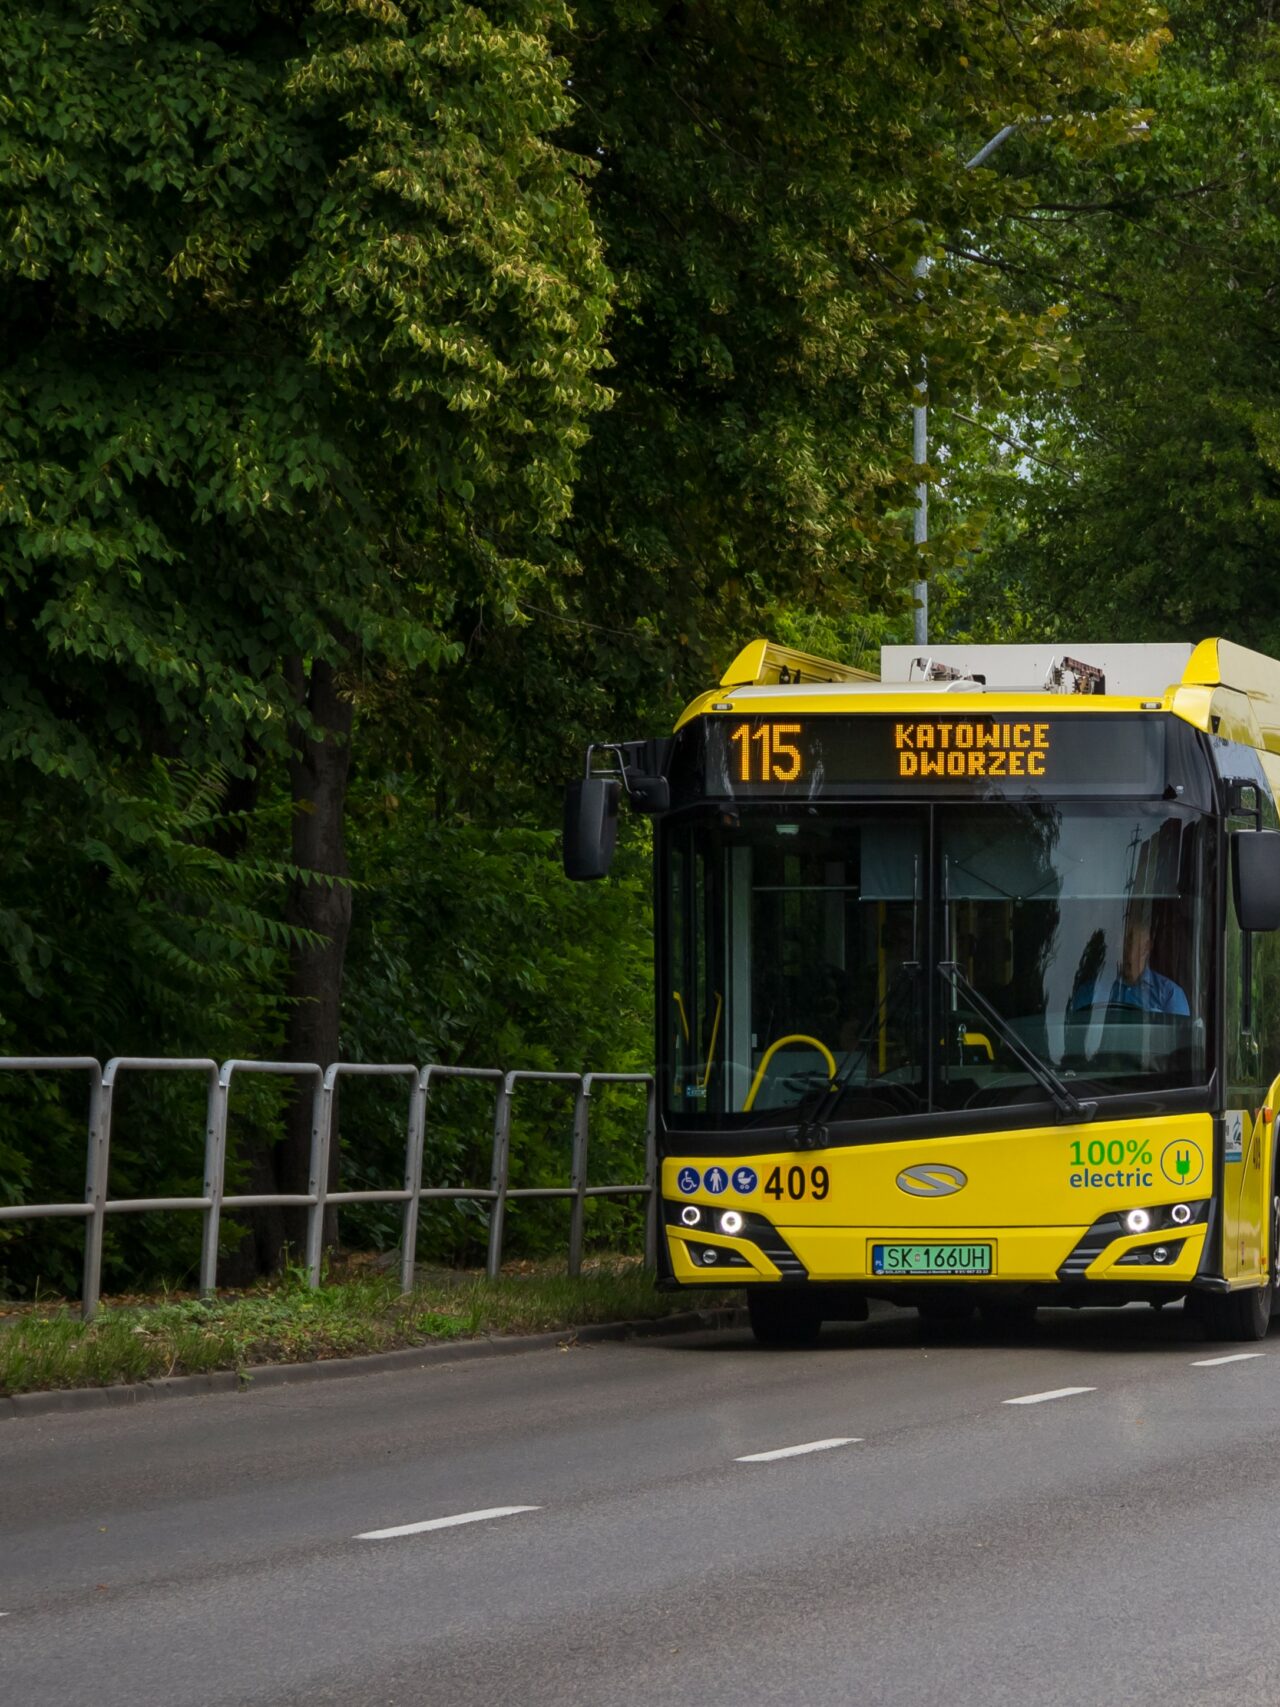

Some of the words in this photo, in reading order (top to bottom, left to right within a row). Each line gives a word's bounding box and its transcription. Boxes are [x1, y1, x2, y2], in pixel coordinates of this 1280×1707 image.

[895, 724, 1050, 748] KATOWICE
[732, 724, 801, 780] 115
[900, 751, 1046, 776] DWORZEC
[1070, 1139, 1153, 1166] 100%
[764, 1165, 830, 1201] 409
[1070, 1168, 1153, 1188] electric
[887, 1248, 913, 1268] SK
[923, 1248, 985, 1268] 166UH
